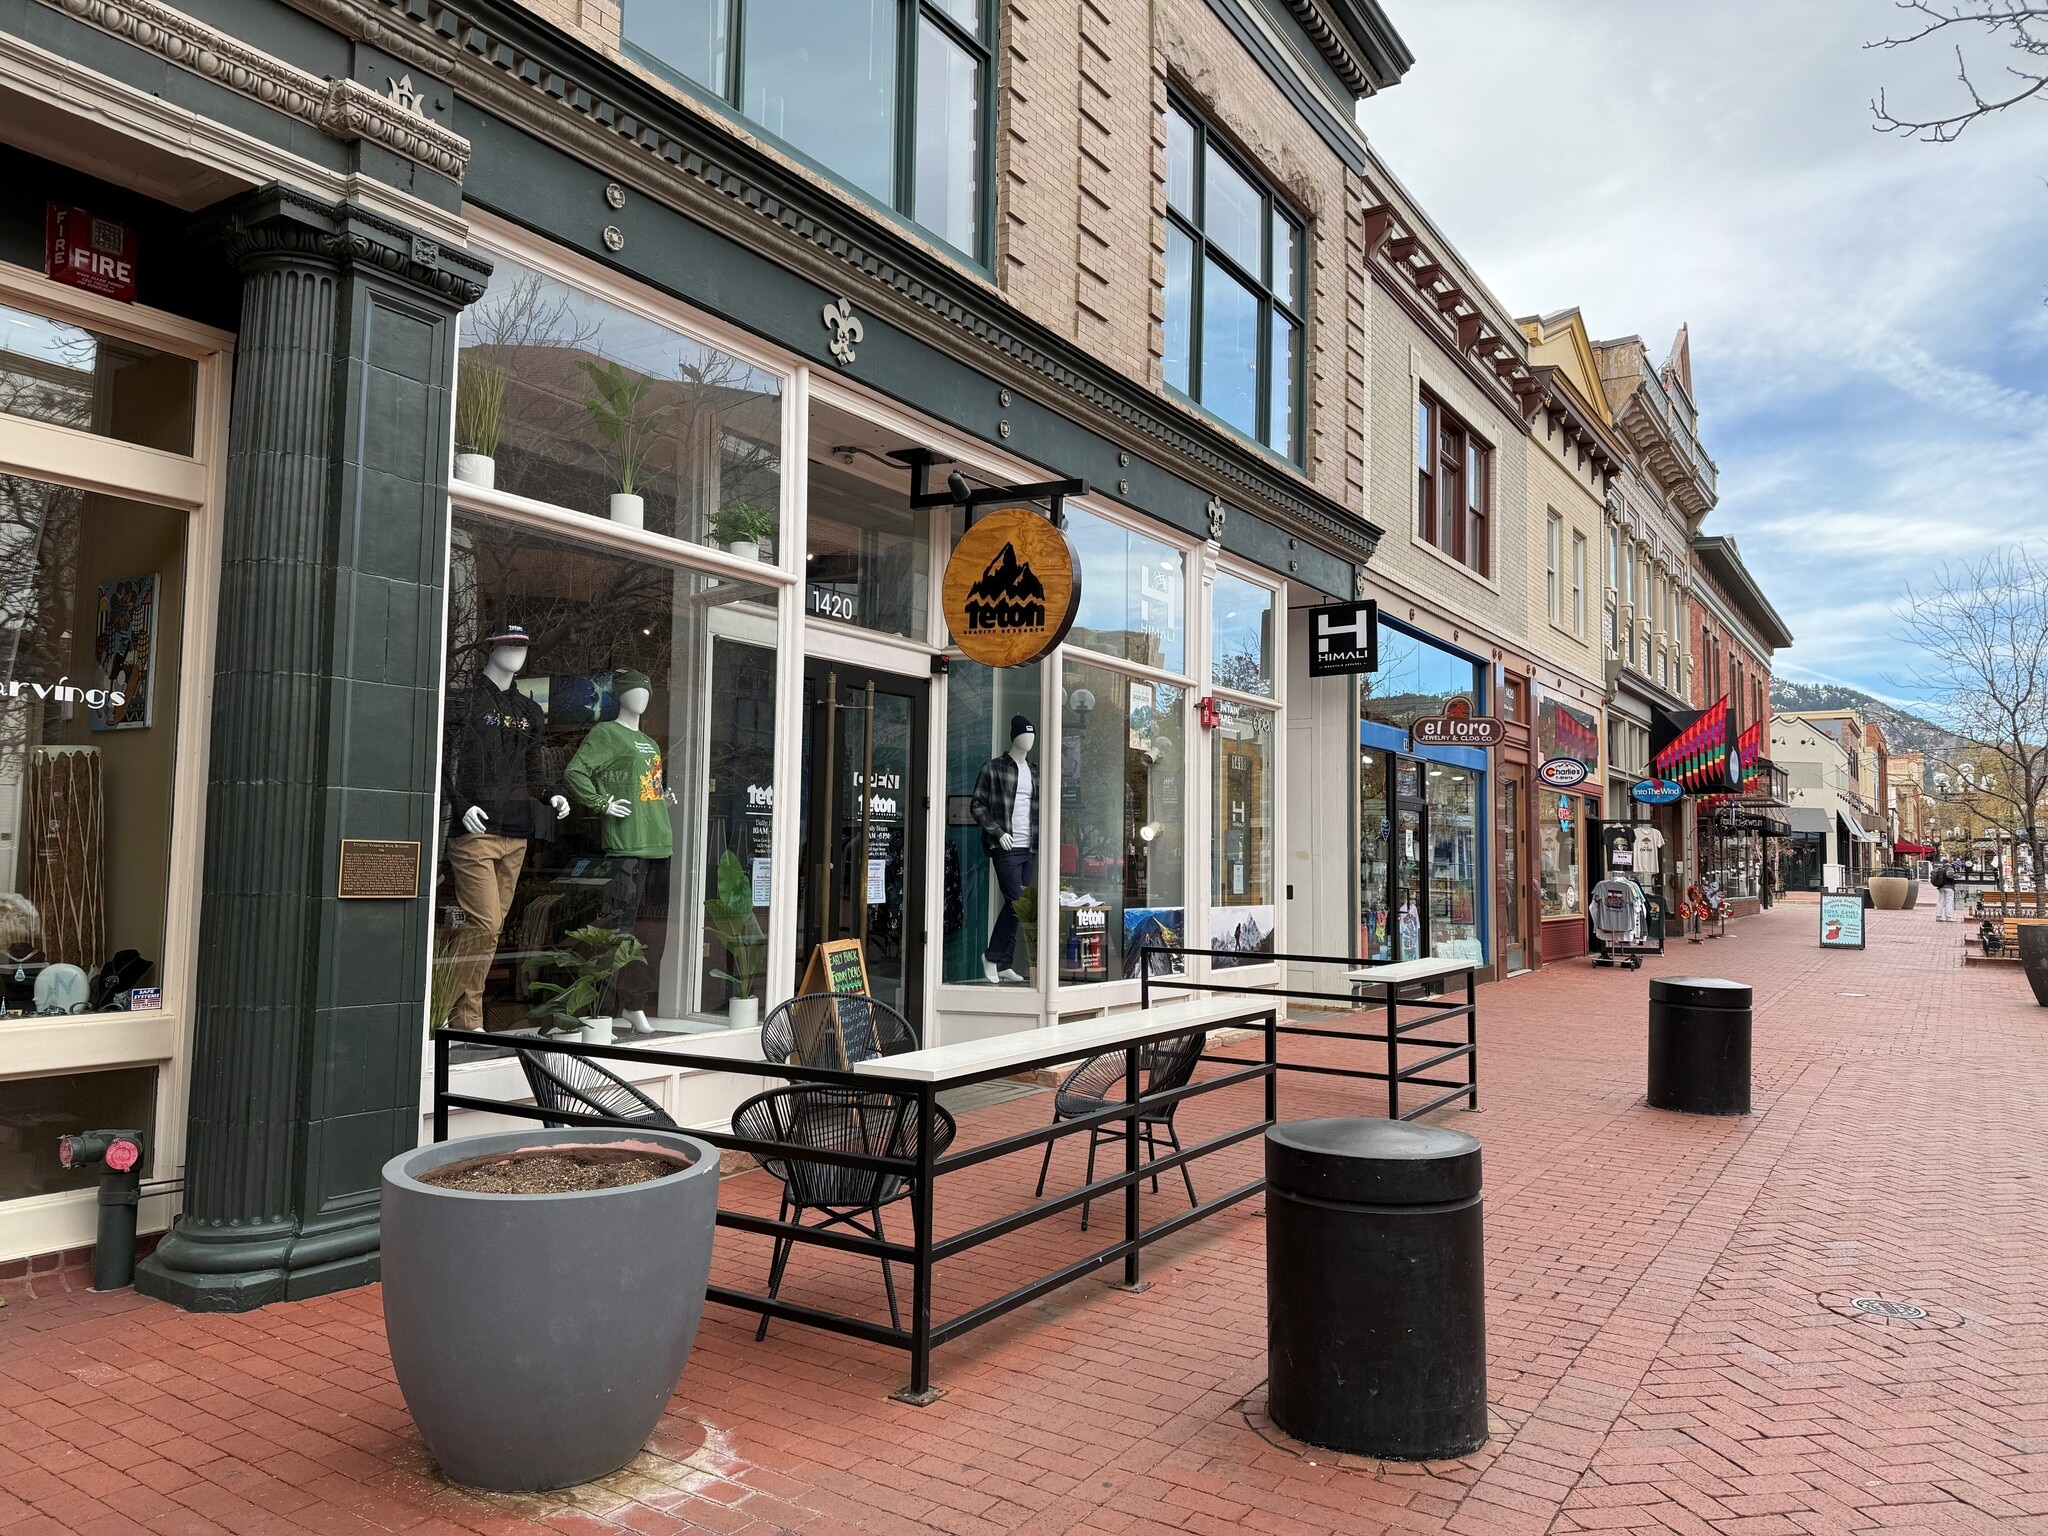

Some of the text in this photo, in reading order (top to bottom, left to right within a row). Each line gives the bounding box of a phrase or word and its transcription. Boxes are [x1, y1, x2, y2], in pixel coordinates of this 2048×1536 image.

[54, 211, 67, 264] FIRE
[74, 247, 131, 283] FIRE
[813, 591, 852, 620] 1420
[1141, 623, 1175, 643] HIMALI
[1318, 650, 1368, 662] HIMALI
[1424, 721, 1491, 735] el loro
[1546, 767, 1581, 777] Charlie's
[1634, 787, 1680, 796] Into The Wind
